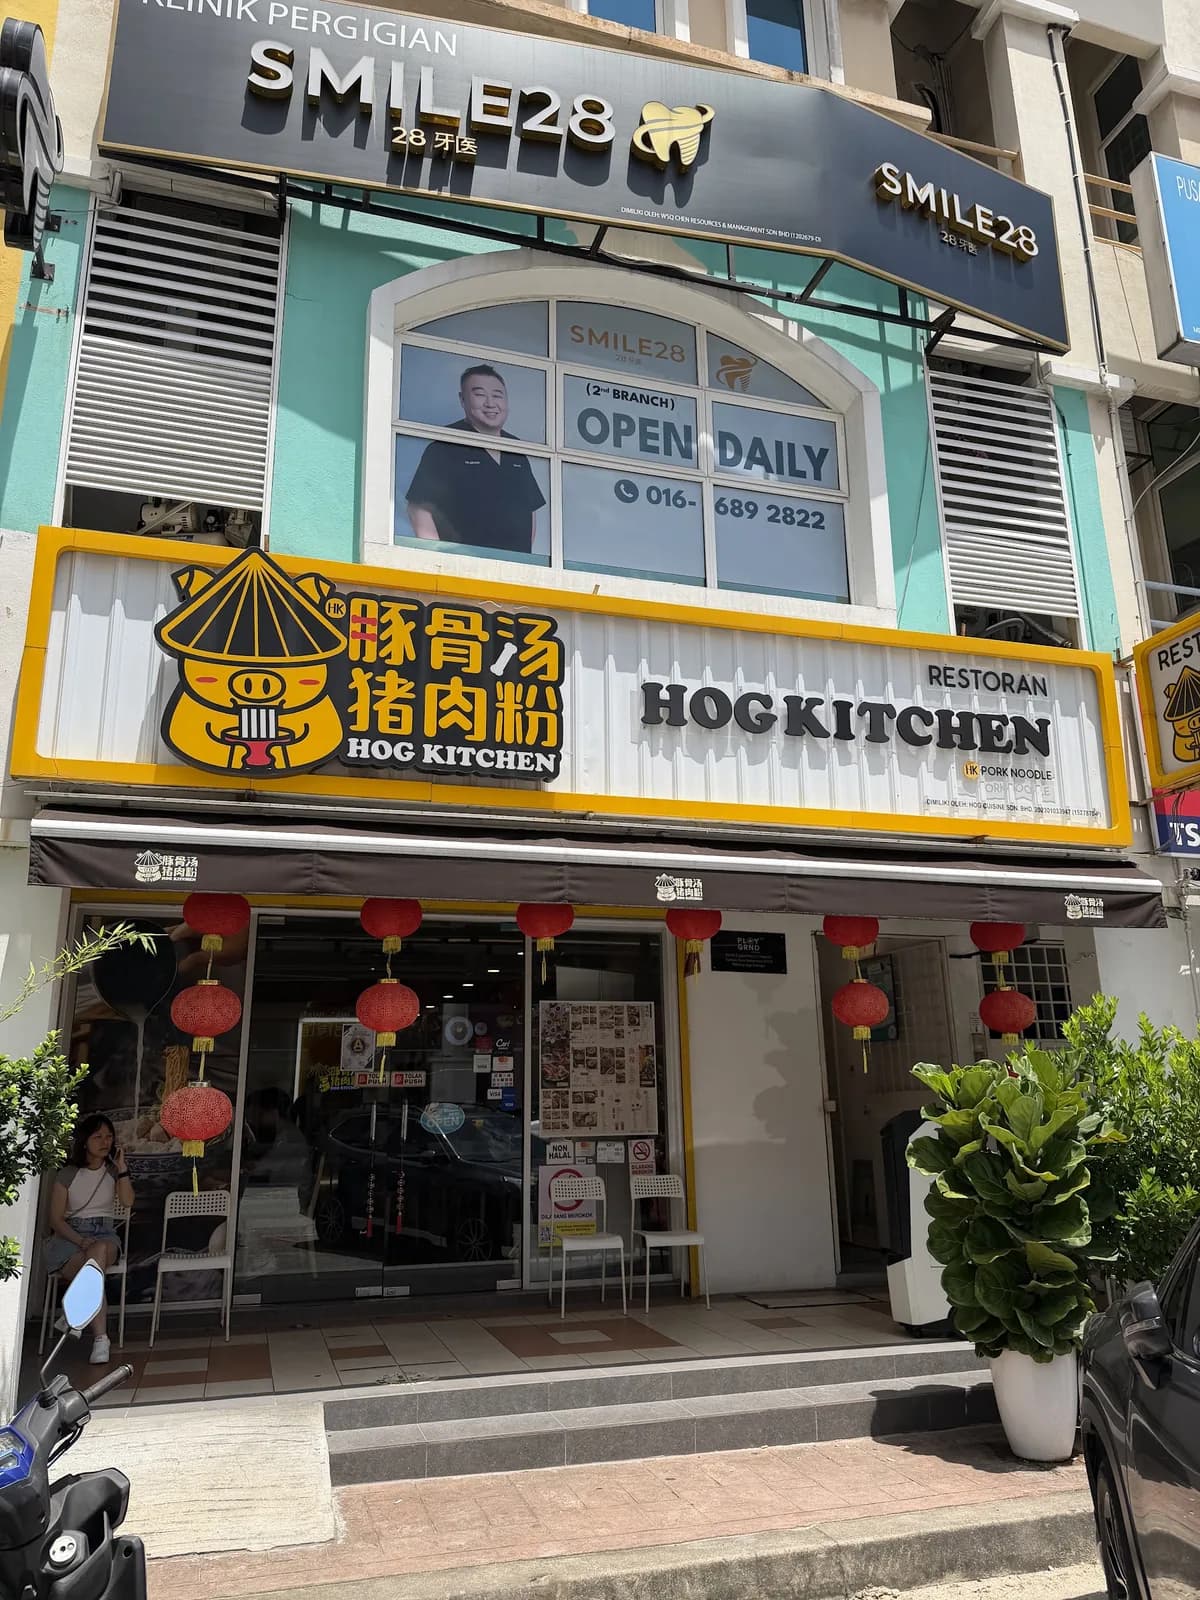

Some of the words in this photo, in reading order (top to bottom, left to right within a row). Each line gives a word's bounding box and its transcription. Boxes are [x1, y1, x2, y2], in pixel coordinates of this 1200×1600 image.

[268, 5, 458, 57] PERGIGIAN
[247, 40, 616, 147] SMILE28
[391, 126, 427, 147] 28
[433, 130, 479, 156] 牙医
[1176, 175, 1200, 203] PUS
[675, 215, 690, 223] CHEN
[690, 217, 722, 228] RESOURCES
[727, 222, 765, 234] MANAGEMENT
[766, 228, 777, 236] SDN
[874, 161, 1039, 259] SMILE28
[940, 230, 957, 247] 28
[569, 324, 686, 363] SMILE28
[586, 382, 610, 397] (2nd
[612, 388, 675, 411] BRANCH)
[577, 407, 693, 460] OPEN
[718, 430, 829, 481] DAILY
[646, 485, 697, 509] 016-
[714, 497, 758, 520] 689
[766, 504, 825, 530] 2822
[327, 602, 345, 616] HK
[348, 597, 561, 683] 豚骨汤
[928, 664, 1048, 697] RESTORAN
[347, 667, 559, 748] 猪肉粉
[640, 681, 778, 735] HOG
[783, 694, 1051, 758] KITCHEN
[347, 737, 416, 764] HOG
[421, 743, 557, 774] KITCHEN
[965, 763, 978, 777] HK
[980, 766, 1009, 778] PORK
[1010, 768, 1052, 781] NOODLE
[969, 801, 981, 809] HOG
[552, 1144, 568, 1152] NON
